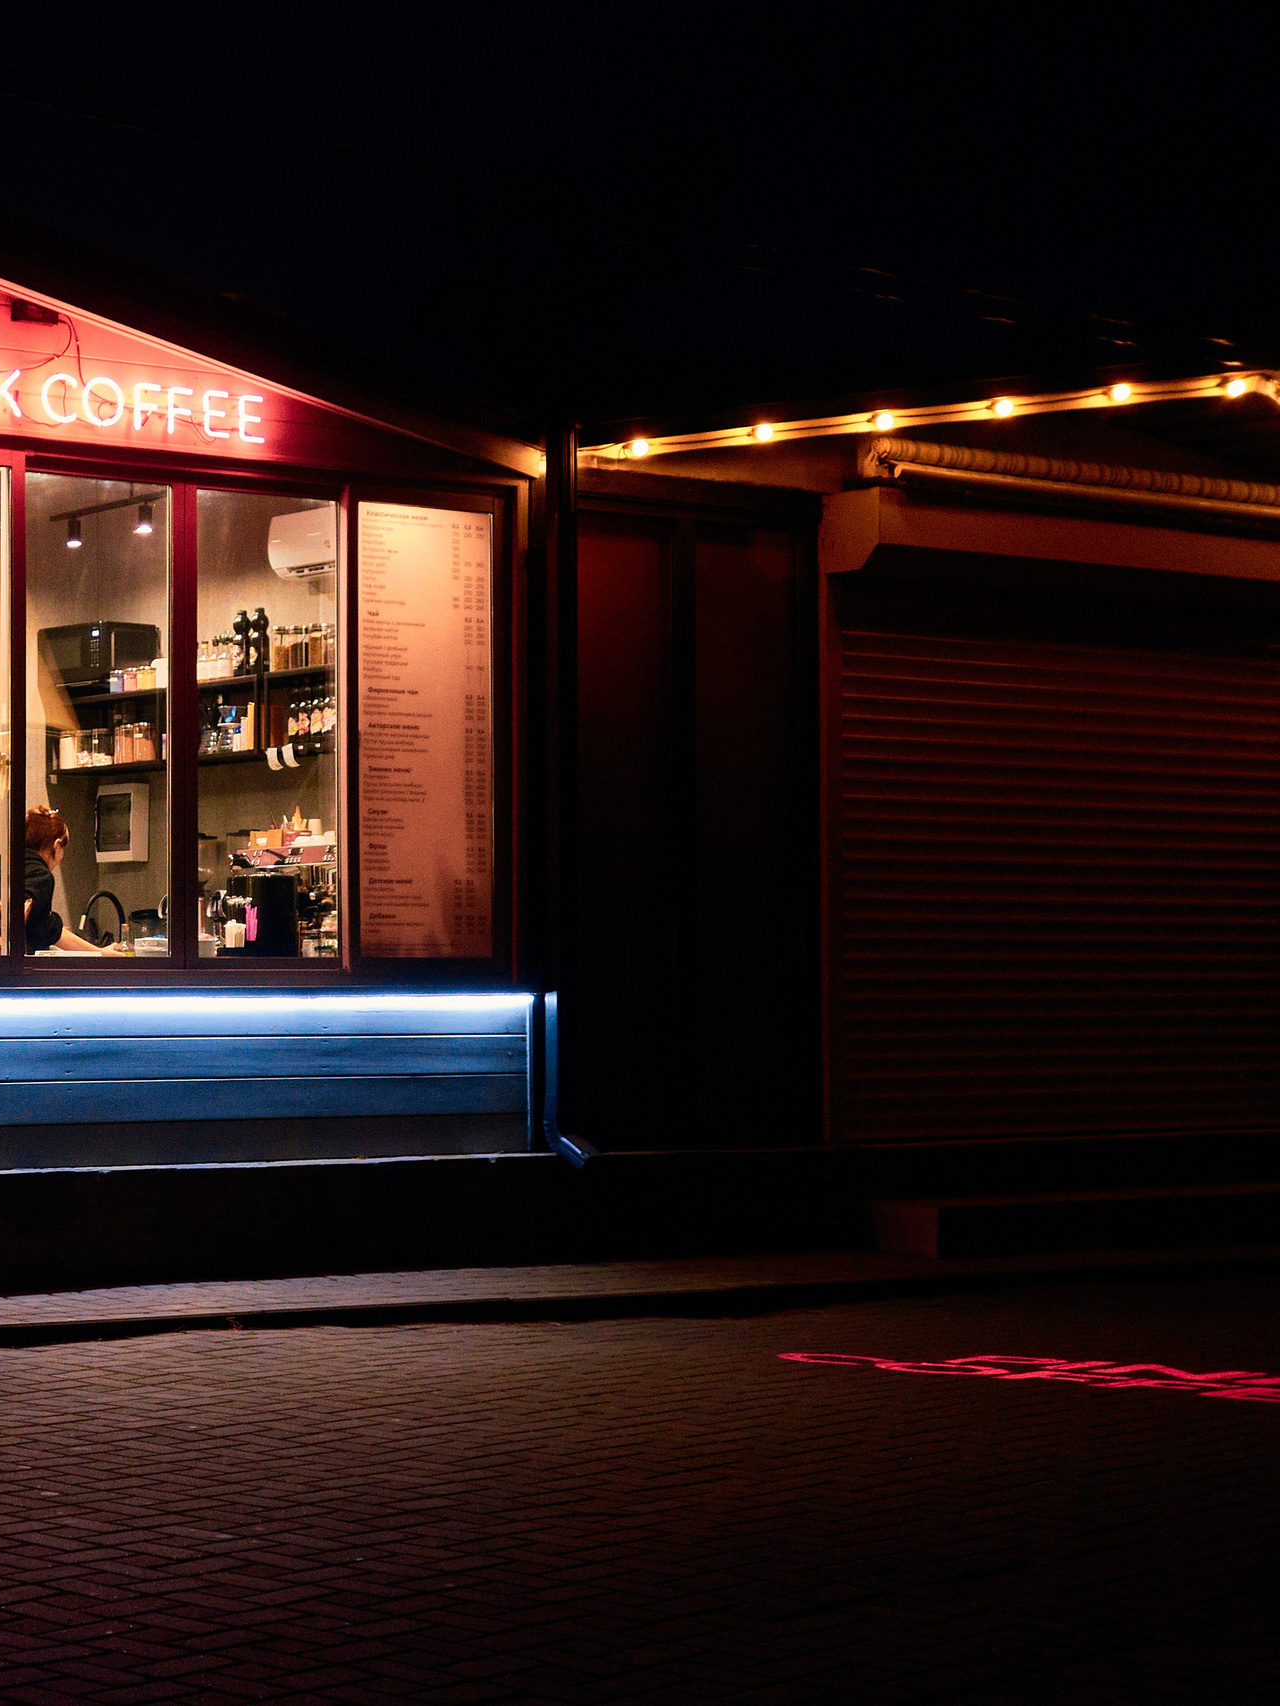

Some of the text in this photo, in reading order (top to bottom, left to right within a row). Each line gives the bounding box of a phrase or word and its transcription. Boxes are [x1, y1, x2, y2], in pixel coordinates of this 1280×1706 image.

[40, 372, 267, 444] COFFEE
[366, 510, 409, 519] Классическое
[368, 808, 388, 816] Смузи
